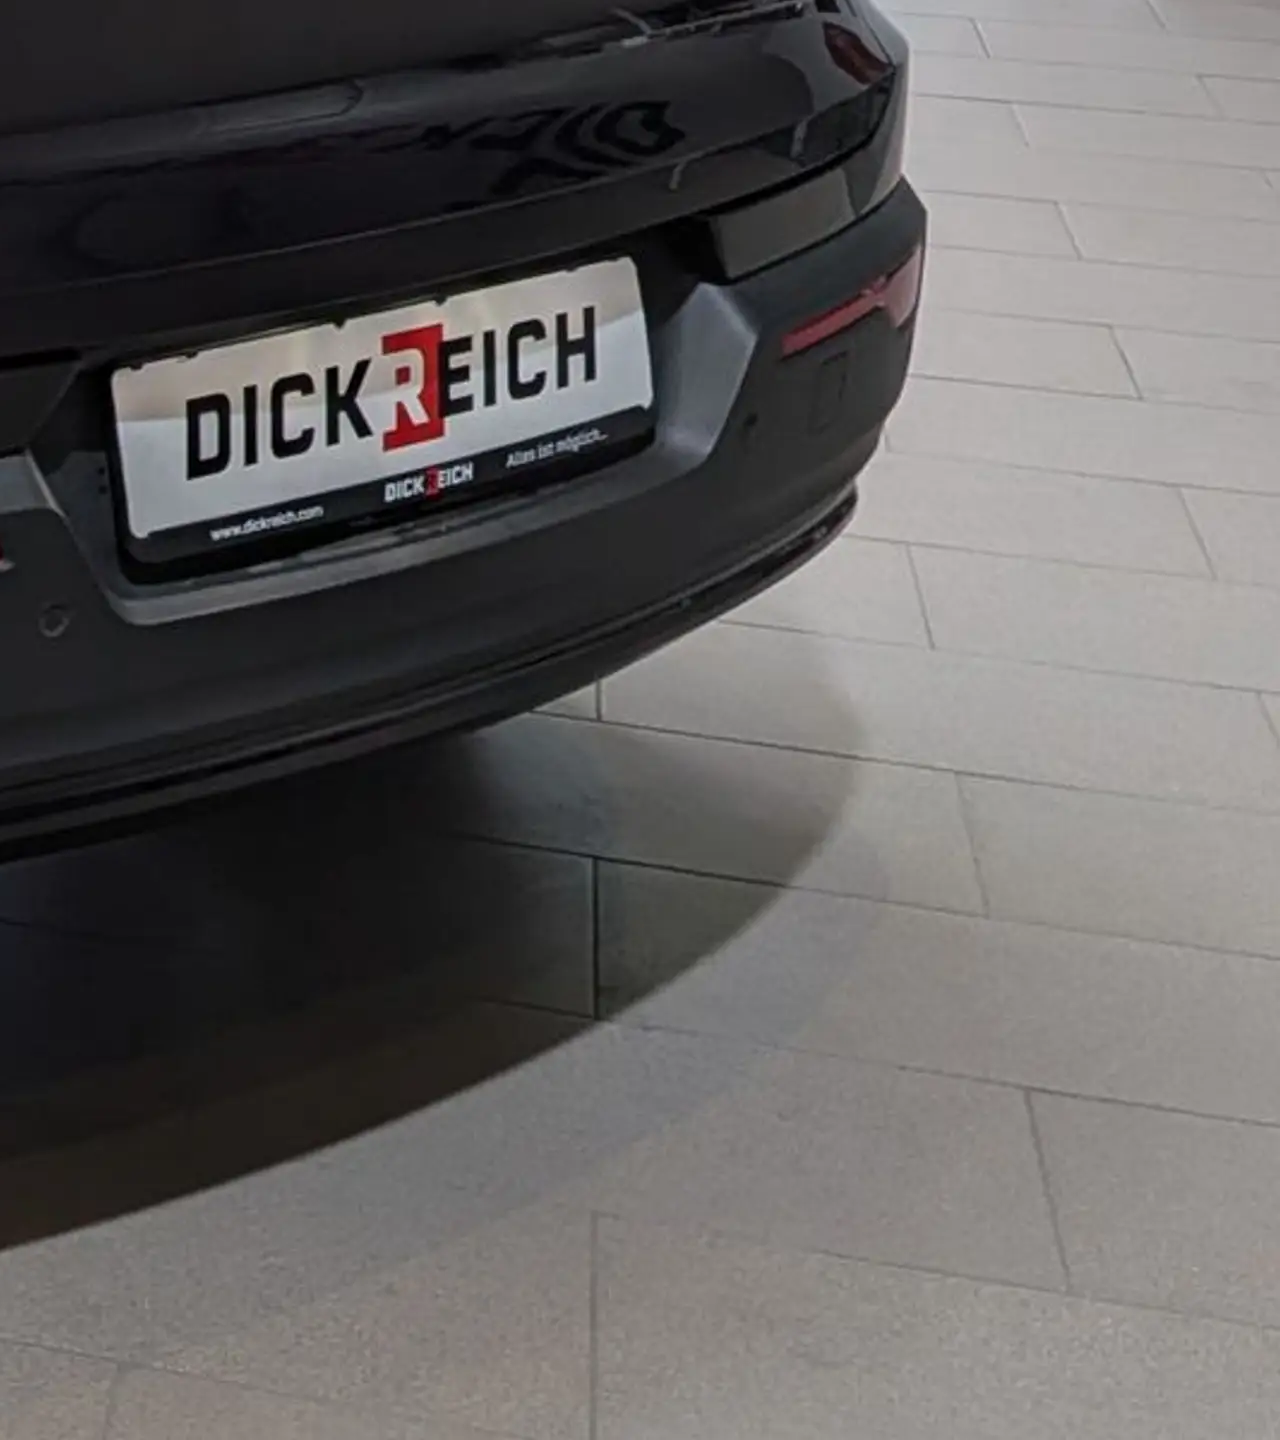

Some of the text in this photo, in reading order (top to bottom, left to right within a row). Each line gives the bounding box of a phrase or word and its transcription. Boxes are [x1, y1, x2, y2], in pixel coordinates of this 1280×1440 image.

[186, 306, 597, 481] DICKREICH
[384, 461, 474, 503] DICKREICH
[209, 506, 324, 541] www.dickreich.com
